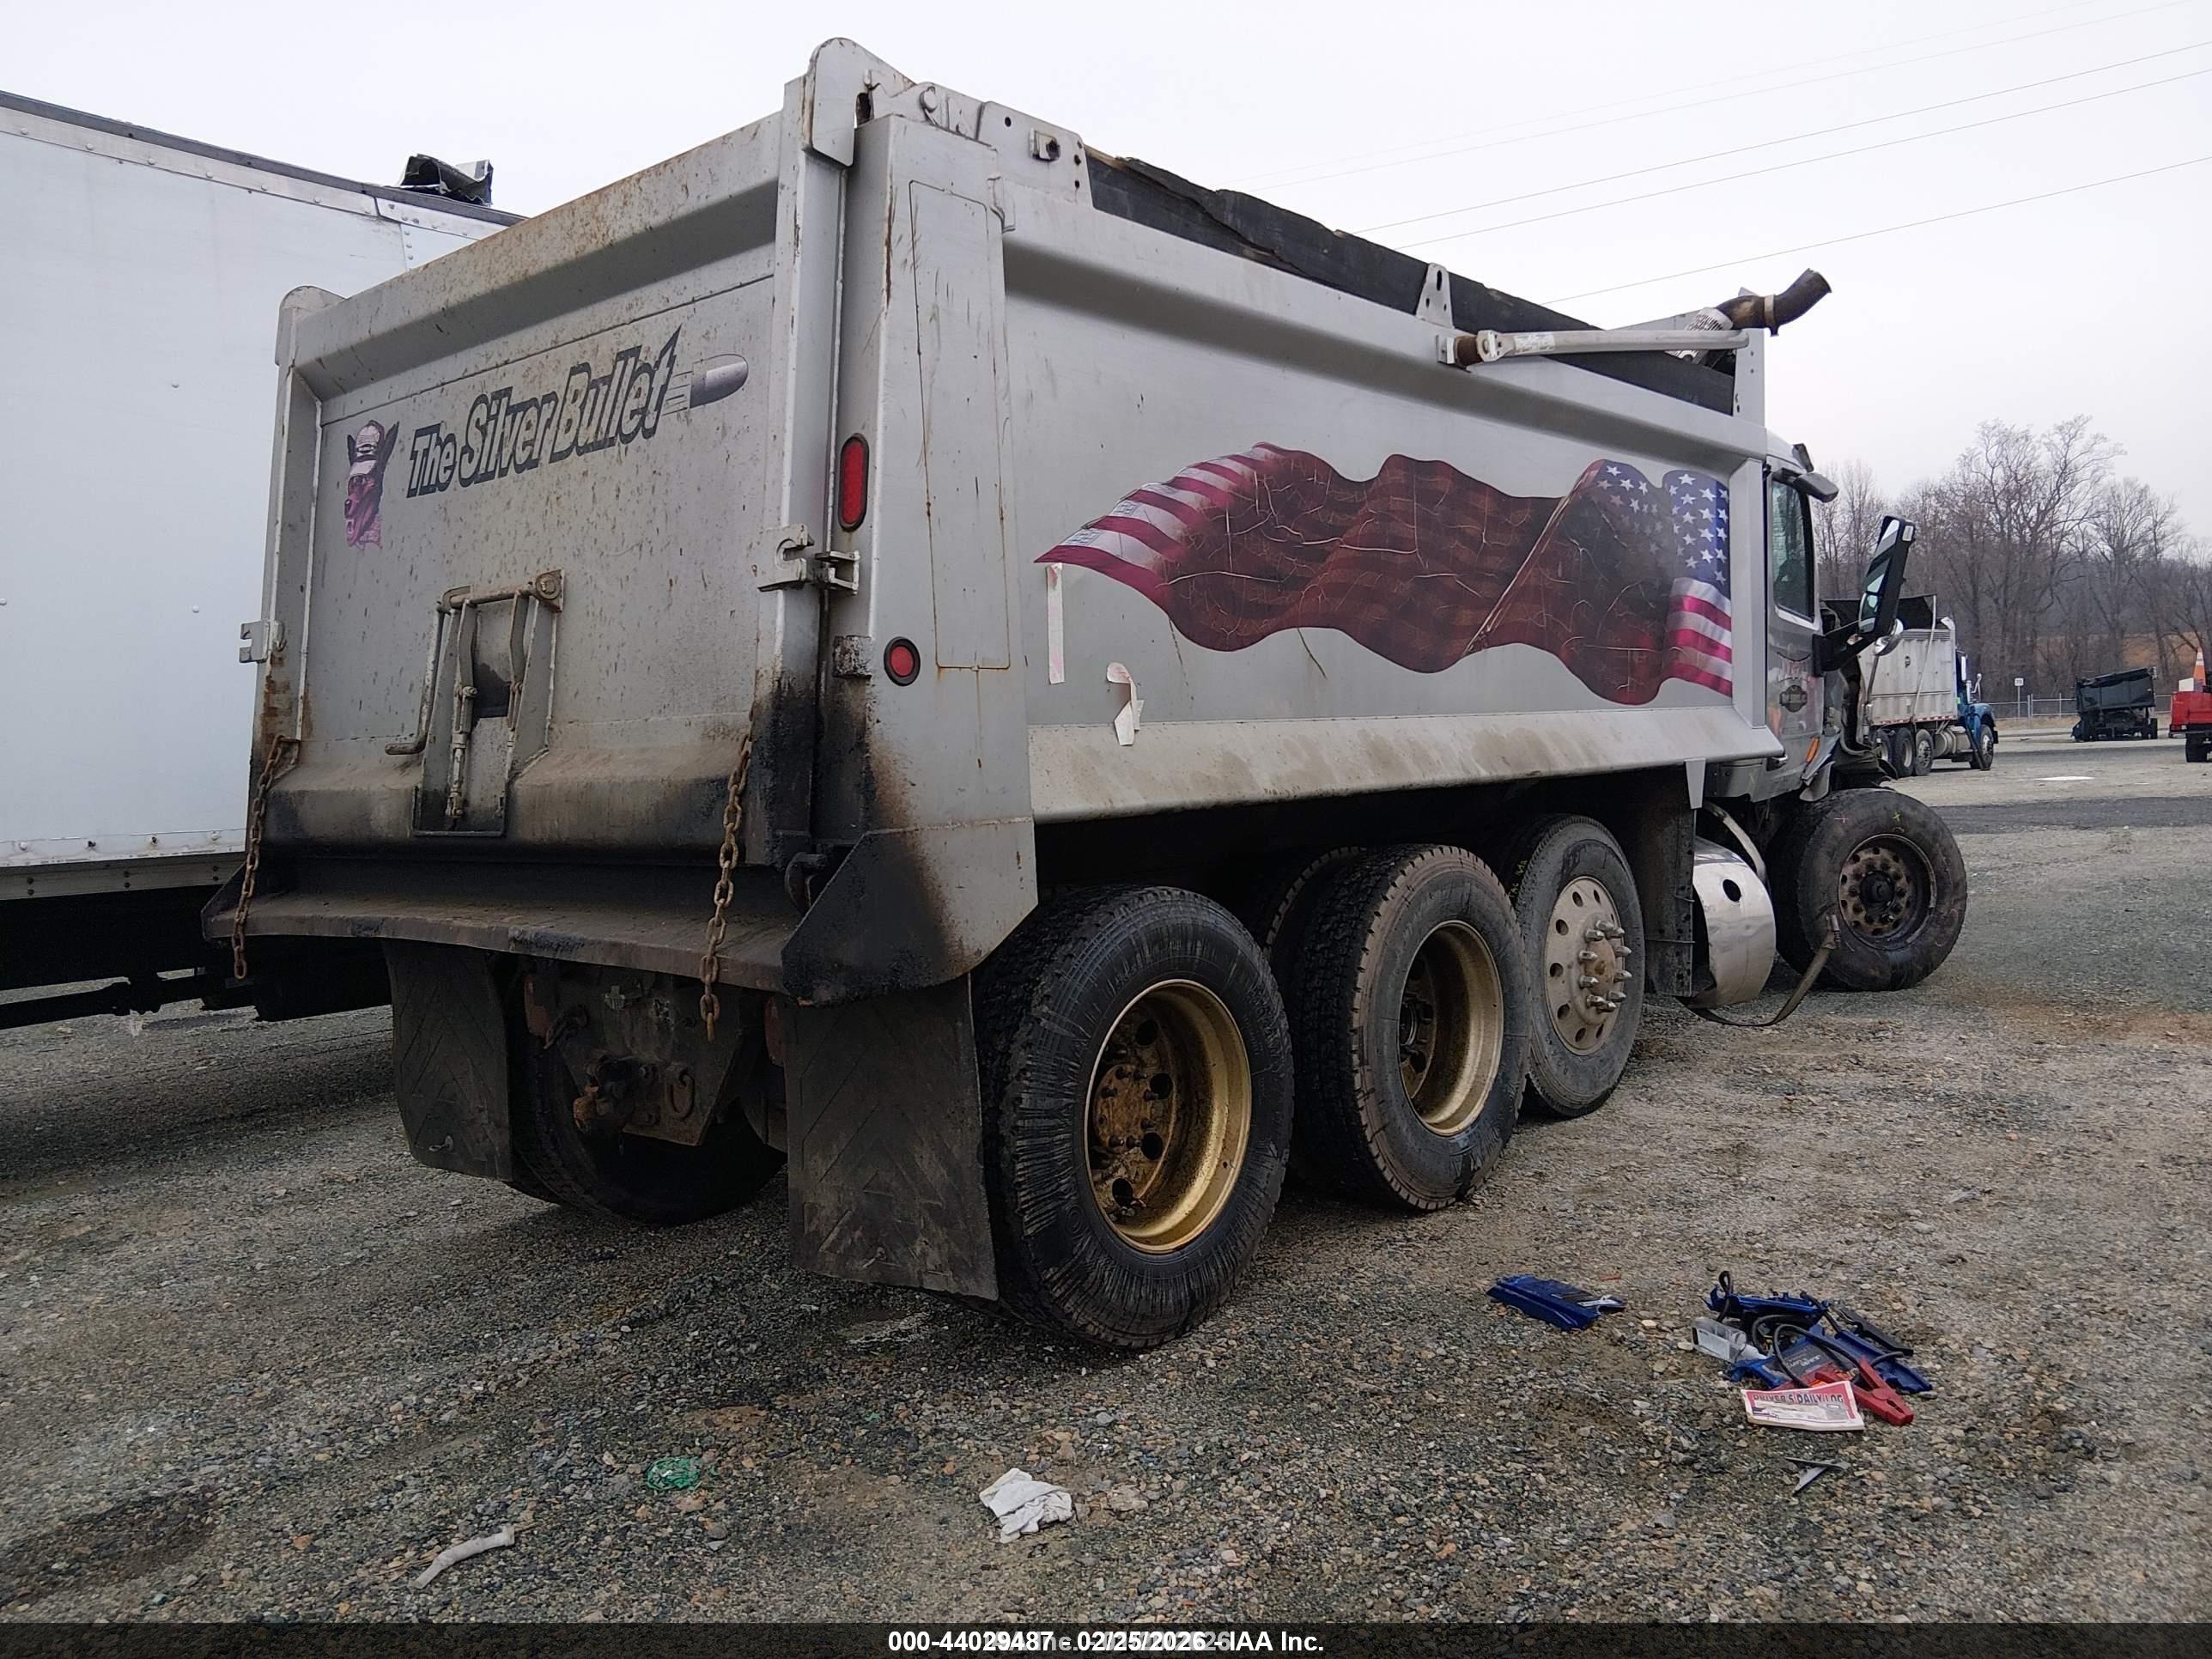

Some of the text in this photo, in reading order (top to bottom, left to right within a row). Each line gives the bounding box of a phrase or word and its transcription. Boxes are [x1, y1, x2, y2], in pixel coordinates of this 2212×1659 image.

[406, 322, 682, 498] The Silver Bullet
[1796, 1394, 1821, 1403] DAILY
